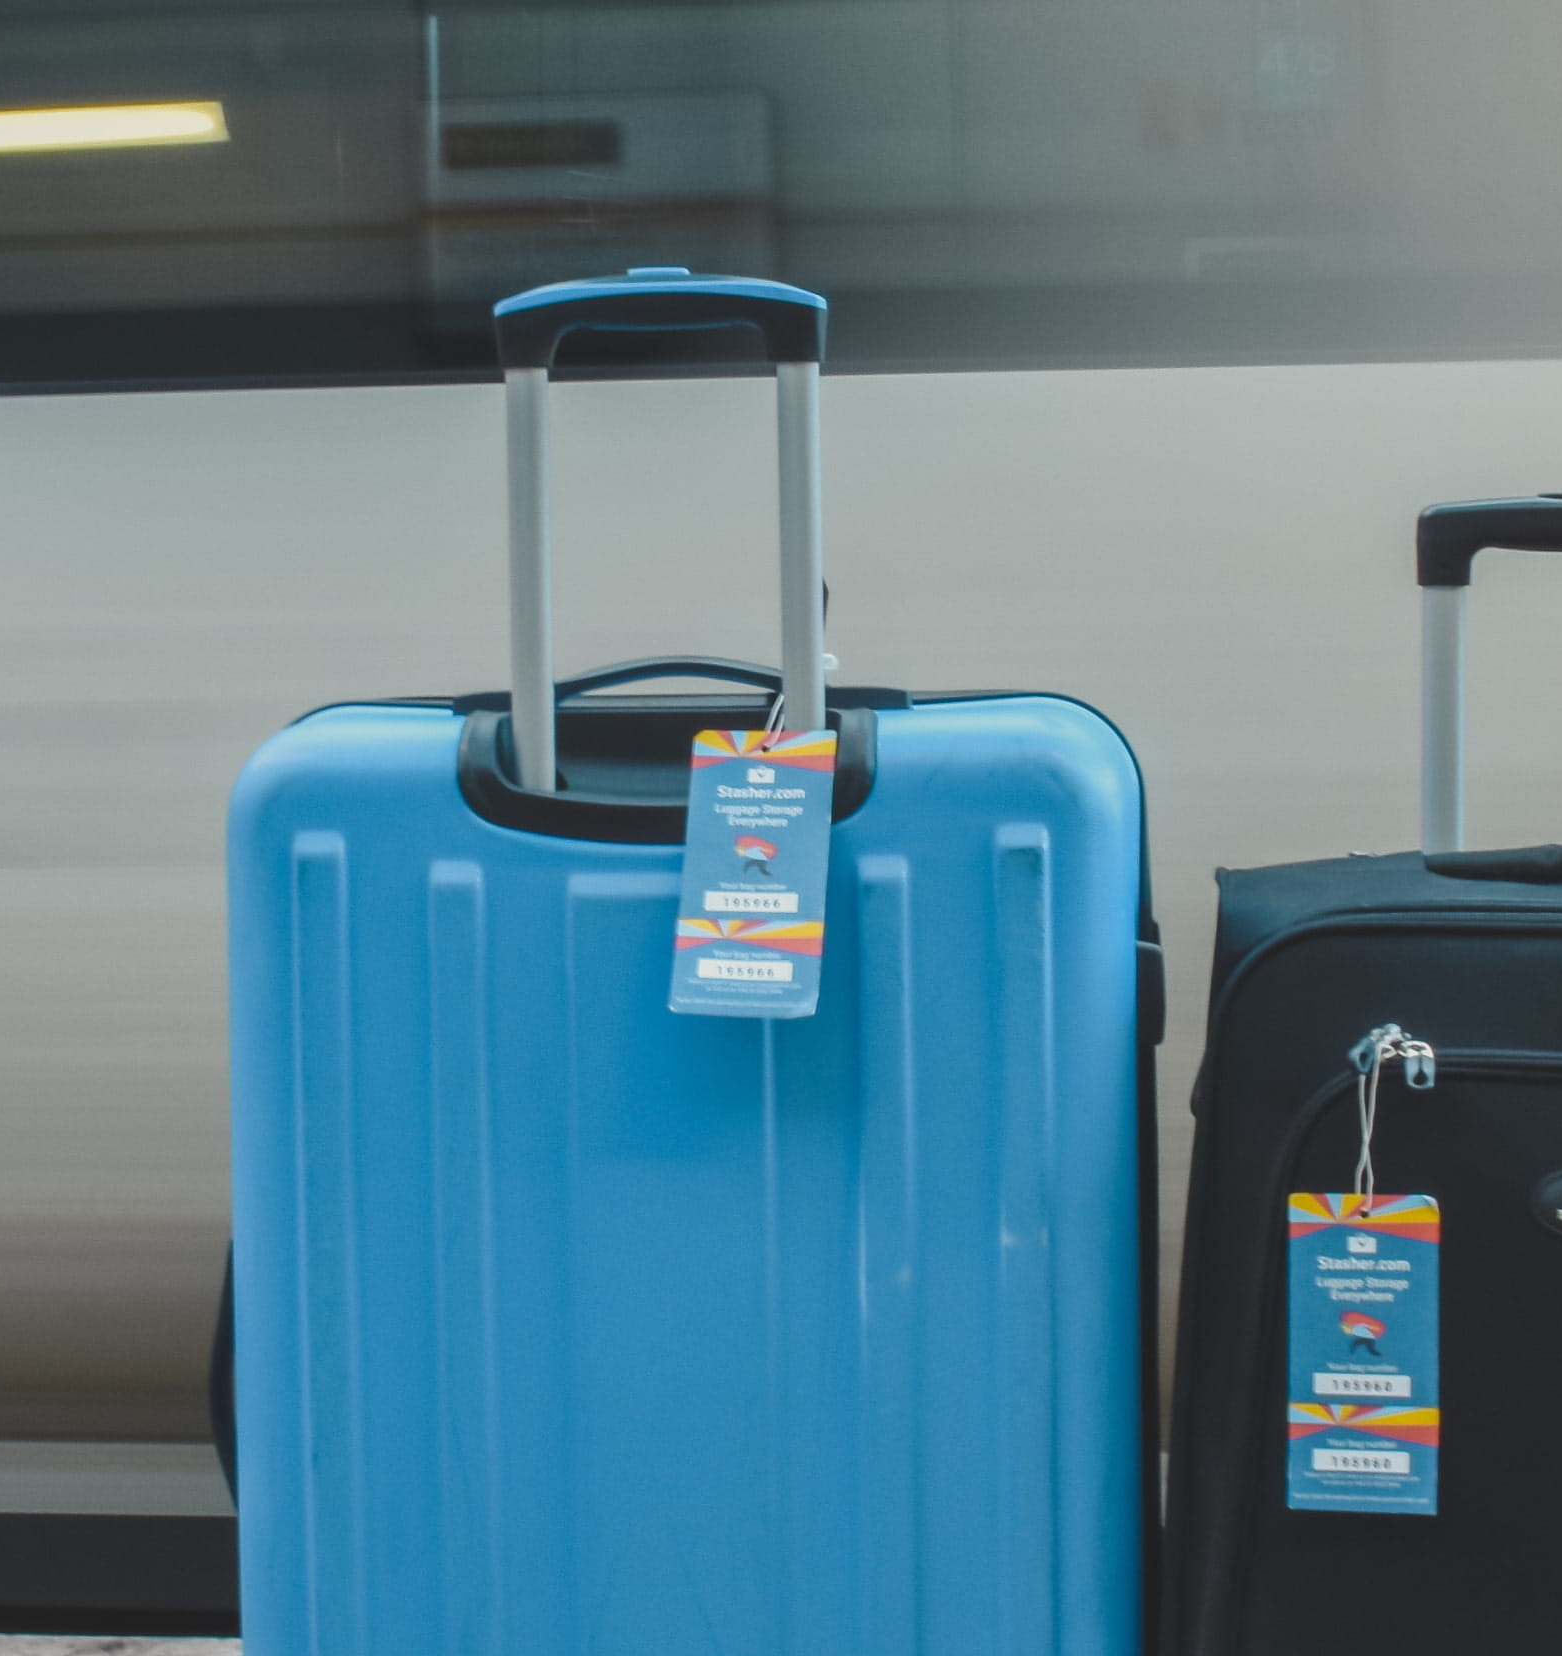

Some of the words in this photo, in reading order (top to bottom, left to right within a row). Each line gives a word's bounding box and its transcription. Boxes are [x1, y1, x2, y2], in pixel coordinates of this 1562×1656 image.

[717, 786, 805, 799] Stasher.com
[715, 804, 760, 816] Luggage
[762, 804, 803, 817] Storage
[729, 816, 788, 828] Everywhere
[1317, 1256, 1411, 1271] Stasher.com
[1316, 1277, 1364, 1290] Luggage
[1366, 1276, 1409, 1291] Storage
[1331, 1290, 1394, 1304] Everywhere
